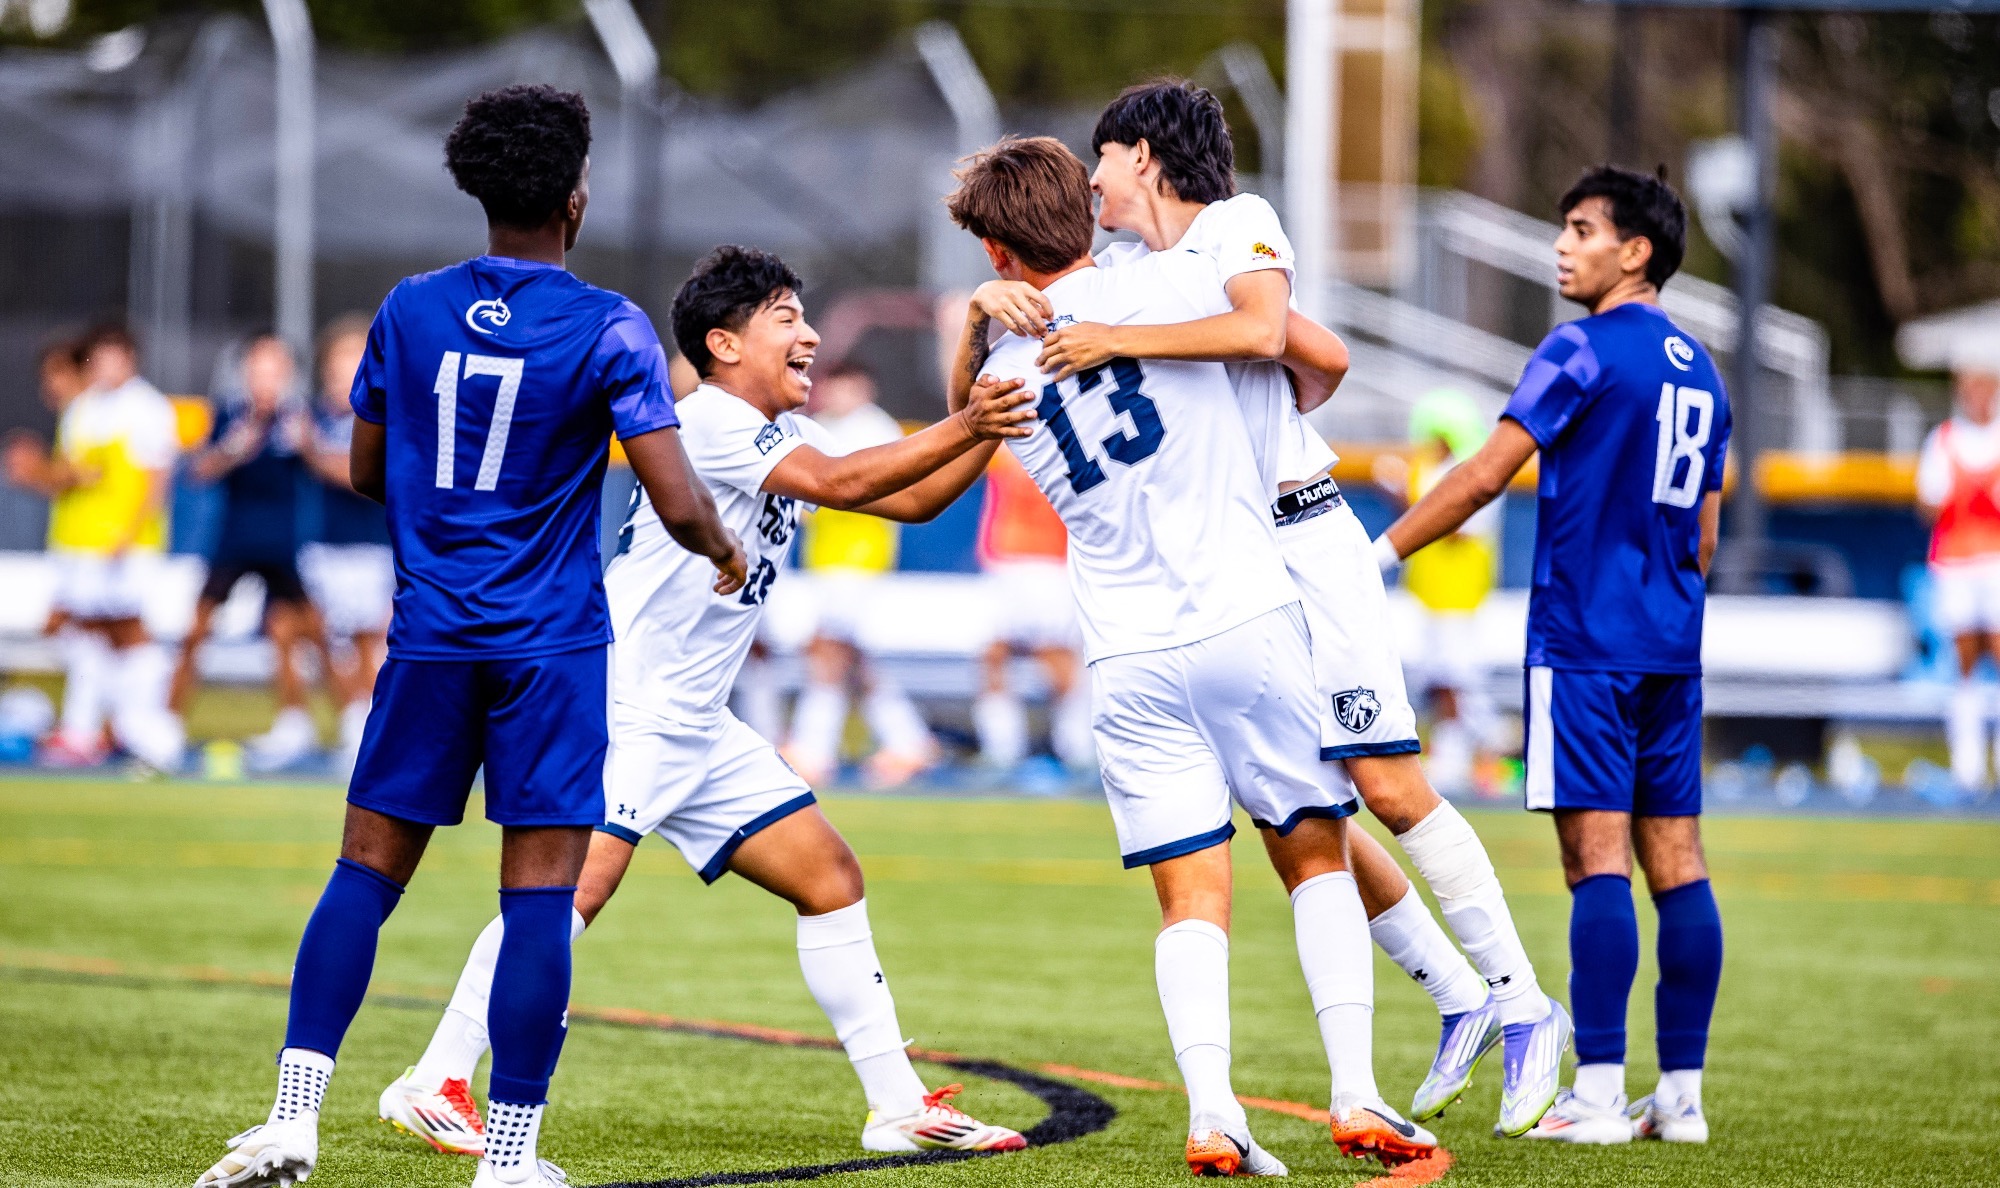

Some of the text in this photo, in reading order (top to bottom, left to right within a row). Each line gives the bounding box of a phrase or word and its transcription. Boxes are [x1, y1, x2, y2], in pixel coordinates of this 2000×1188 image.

[433, 350, 525, 491] 17
[1035, 356, 1168, 497] 13
[1652, 382, 1714, 509] 18
[1295, 481, 1336, 507] Hurley
